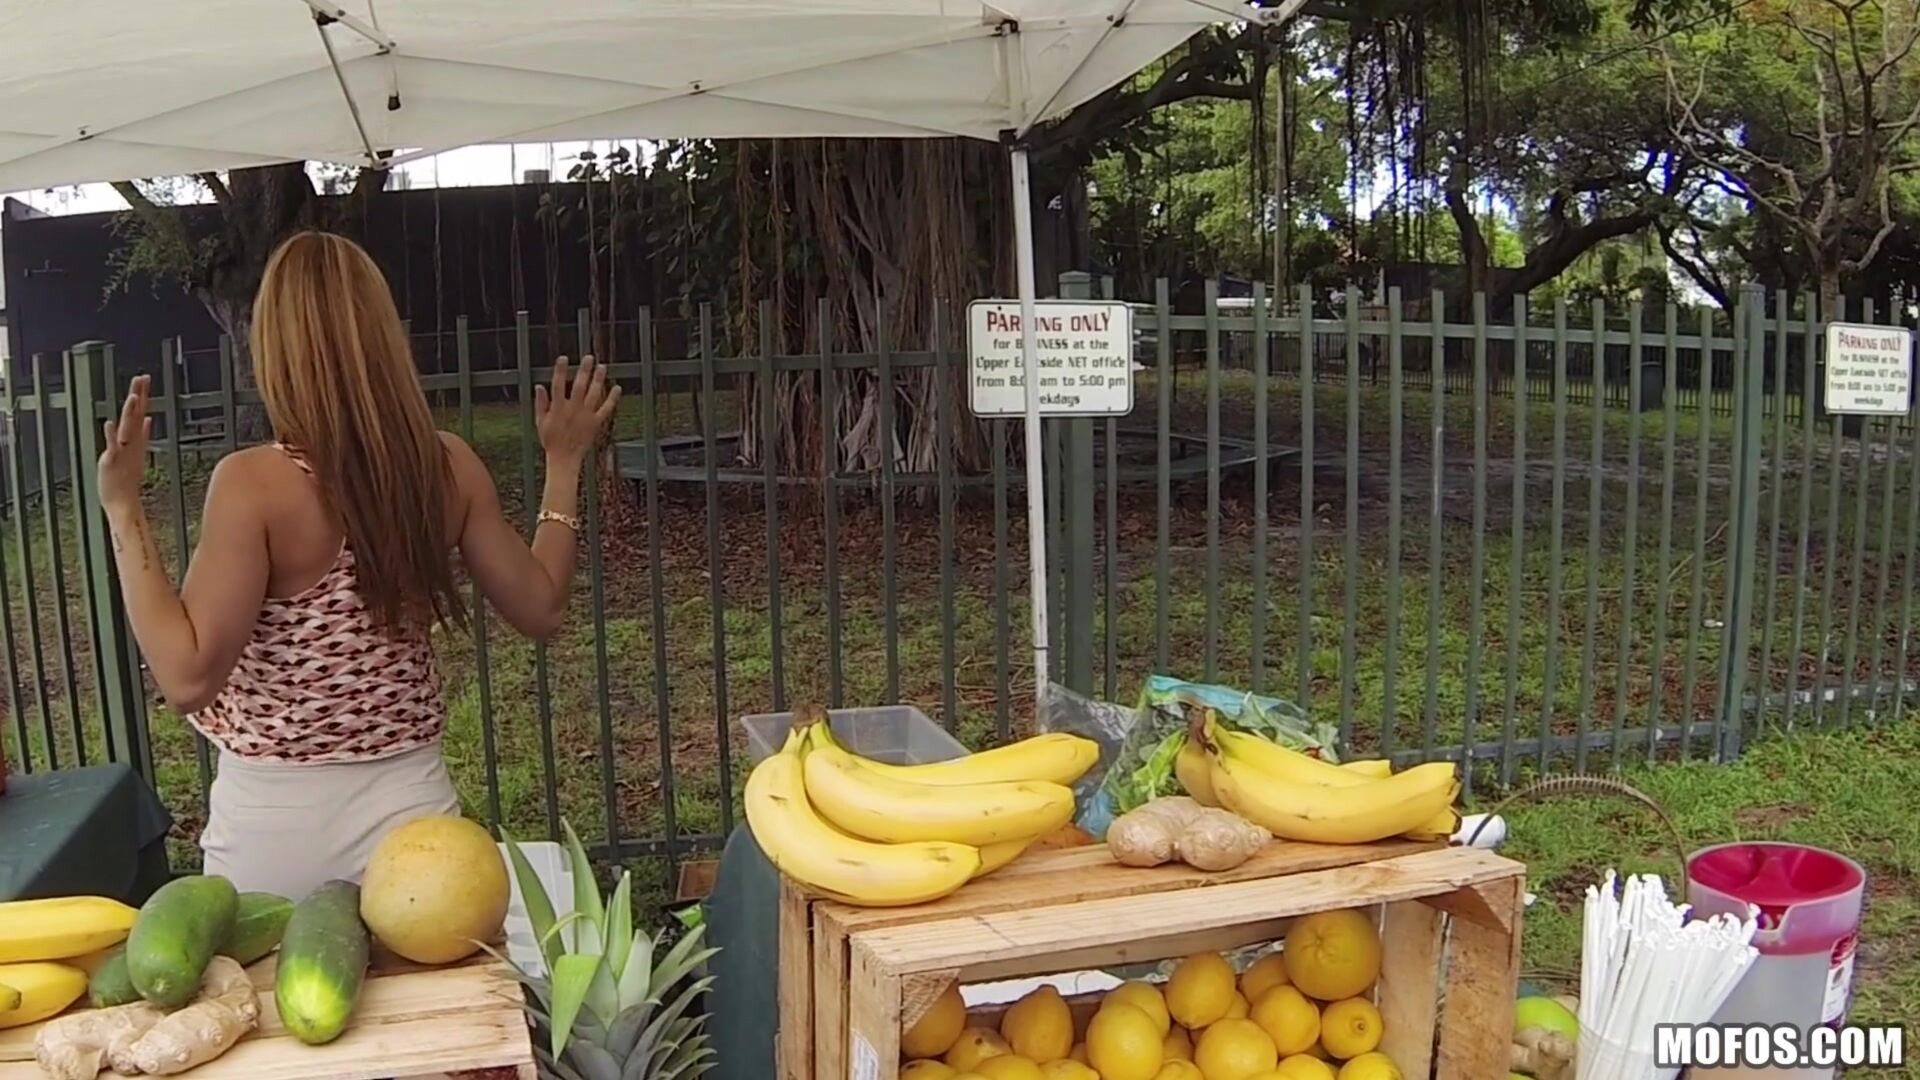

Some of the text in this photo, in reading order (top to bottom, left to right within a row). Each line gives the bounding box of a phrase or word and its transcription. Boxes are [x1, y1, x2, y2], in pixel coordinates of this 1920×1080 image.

[986, 311, 1110, 332] PARING ONLY
[993, 338, 1109, 350] for BINESS at the
[1838, 331, 1901, 351] PARKING ONLY
[1068, 356, 1088, 368] NET
[1092, 356, 1126, 368] office
[976, 376, 1005, 387] from
[1040, 377, 1057, 387] am
[1063, 376, 1075, 387] to
[1079, 375, 1104, 387] 5:00
[1108, 376, 1126, 389] pm
[1039, 393, 1080, 407] ekdays
